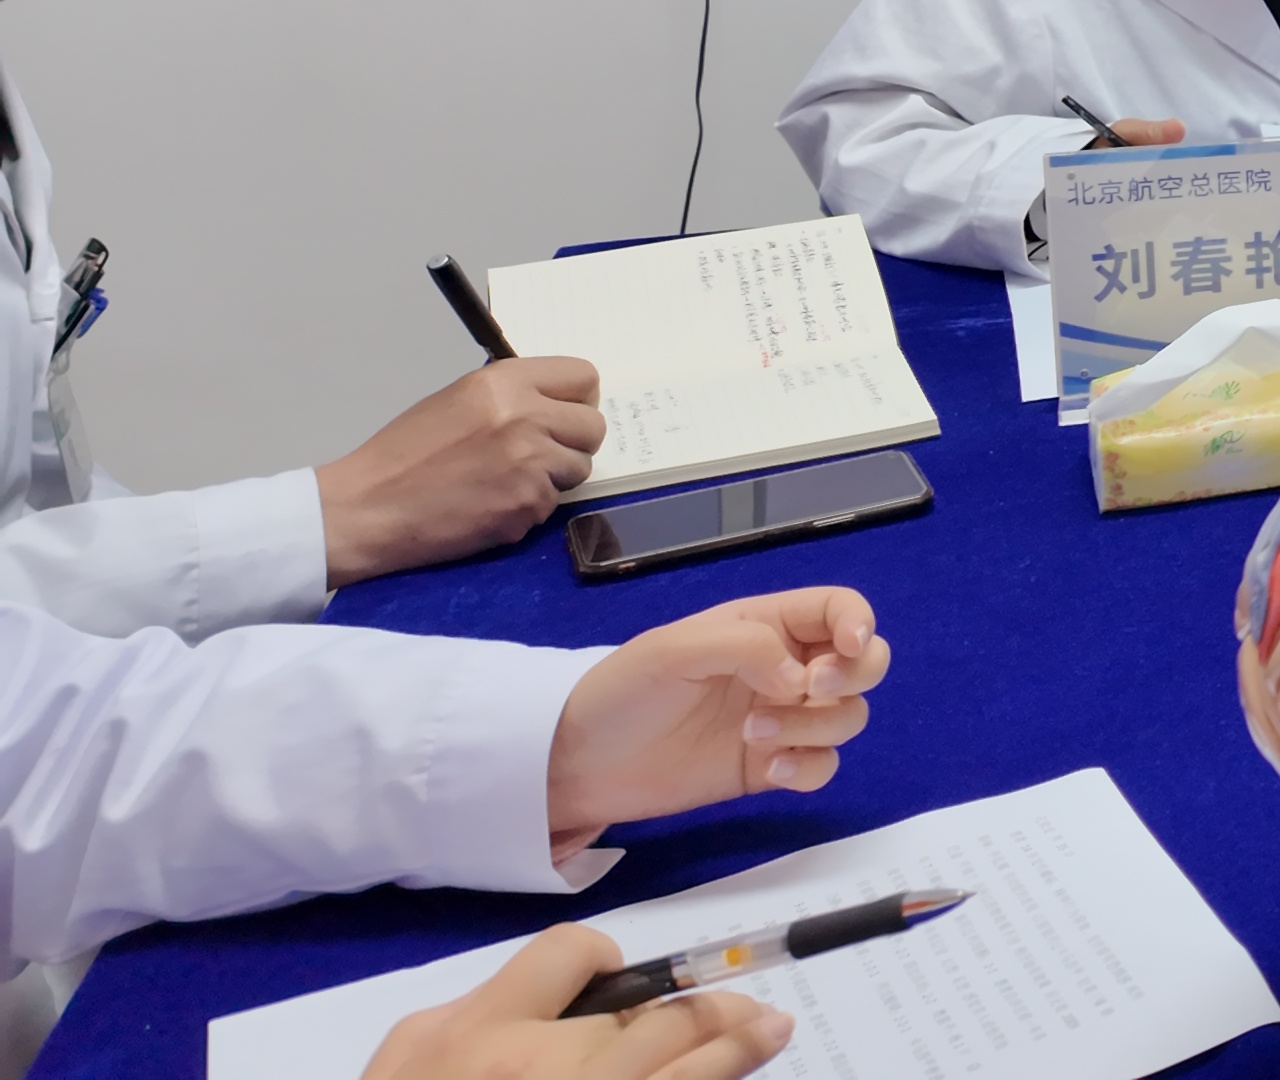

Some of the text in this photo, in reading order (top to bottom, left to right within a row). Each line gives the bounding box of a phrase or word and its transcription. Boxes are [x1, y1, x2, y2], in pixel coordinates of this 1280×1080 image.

[1067, 169, 1273, 206] 北京航空总医院
